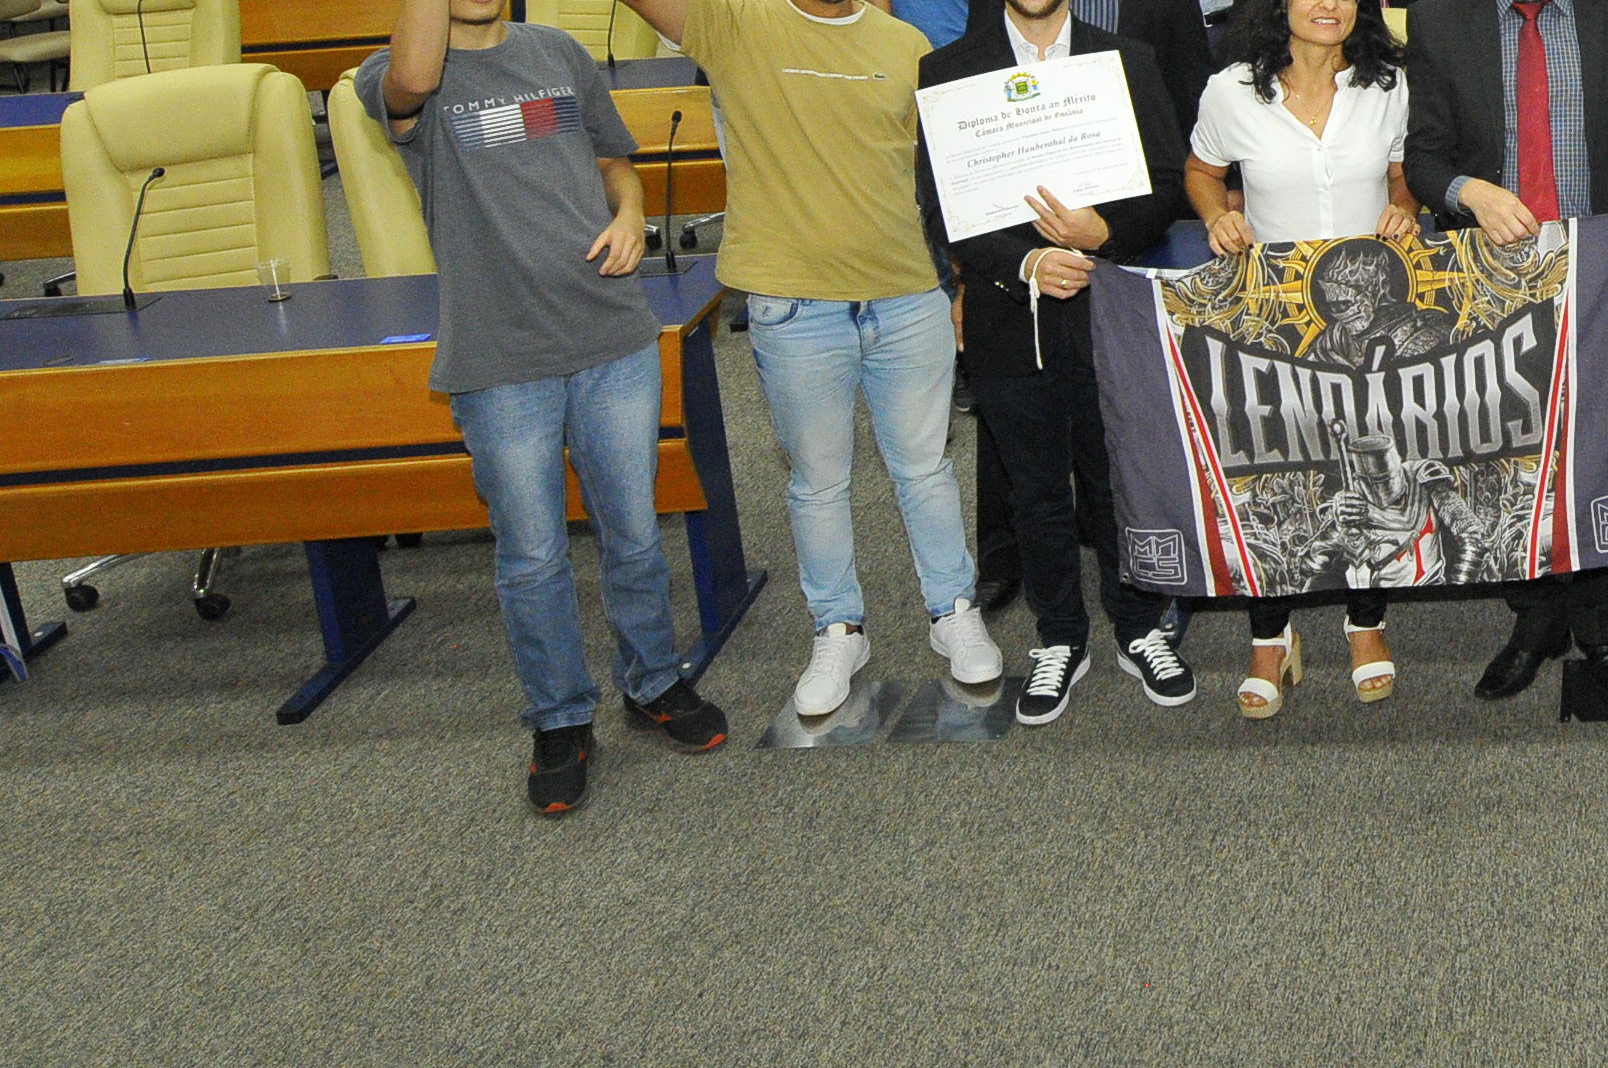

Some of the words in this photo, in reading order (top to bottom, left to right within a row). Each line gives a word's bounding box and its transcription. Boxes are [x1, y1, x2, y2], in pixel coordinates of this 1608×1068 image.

[514, 86, 576, 103] HILFIGER
[956, 114, 998, 131] Diploma
[999, 110, 1011, 120] de
[1014, 103, 1046, 116] Honra
[1048, 100, 1060, 109] ao
[1062, 93, 1096, 107] Mérito
[966, 150, 1014, 168] Christopher
[1016, 136, 1066, 155] Haubenthal
[1067, 134, 1078, 143] da
[1080, 131, 1101, 140] Rosa
[1204, 312, 1544, 469] LENDÁRIOS
